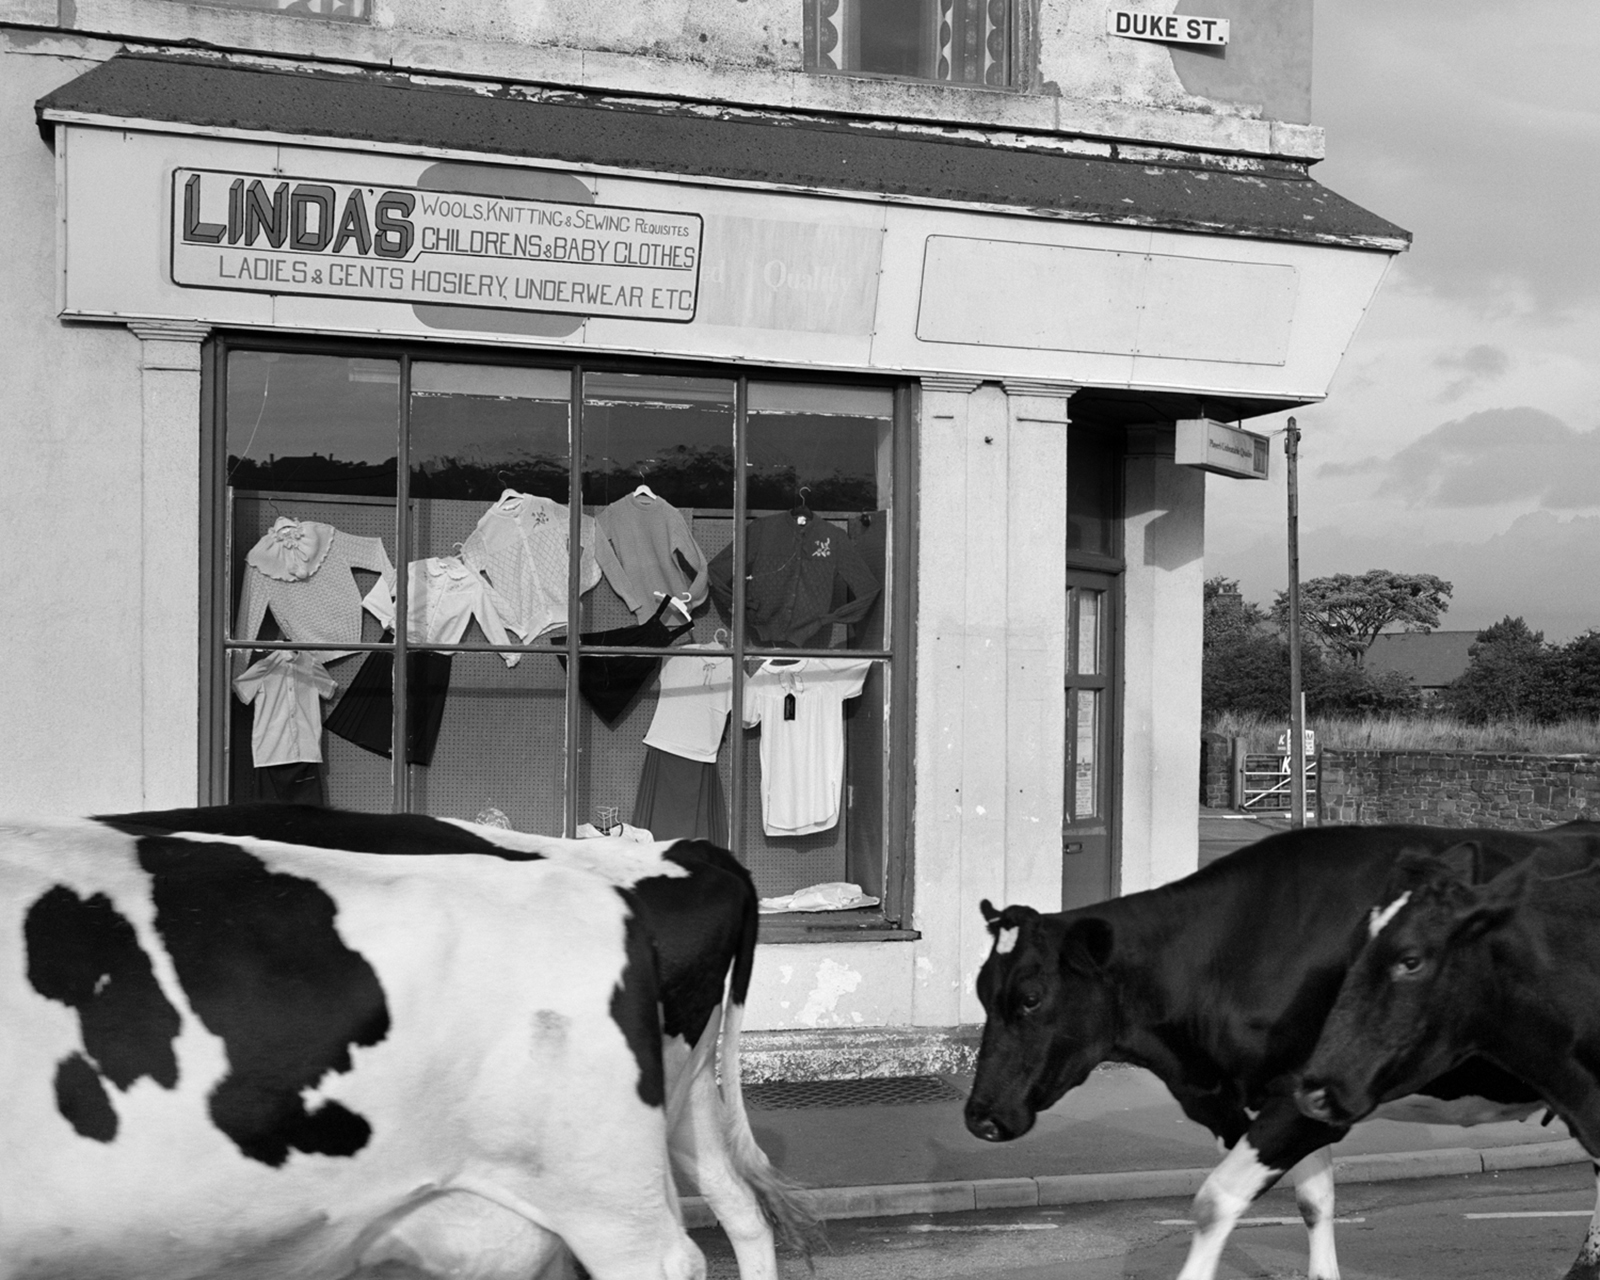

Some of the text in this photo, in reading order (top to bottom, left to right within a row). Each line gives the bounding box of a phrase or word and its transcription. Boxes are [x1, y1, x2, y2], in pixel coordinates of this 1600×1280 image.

[1116, 12, 1224, 41] DUKE ST.
[183, 174, 416, 258] LINDA'S
[573, 209, 630, 232] SEWING
[635, 217, 690, 237] REQUISITES
[422, 226, 542, 258] CHILDRENS
[553, 236, 610, 263] BABY
[613, 241, 696, 268] CLOTHES
[219, 255, 308, 284] LADIES
[311, 268, 323, 284] &
[329, 263, 404, 290] GENTS
[411, 269, 508, 301] HOSIERY,
[514, 277, 643, 308] UNDERWEAR
